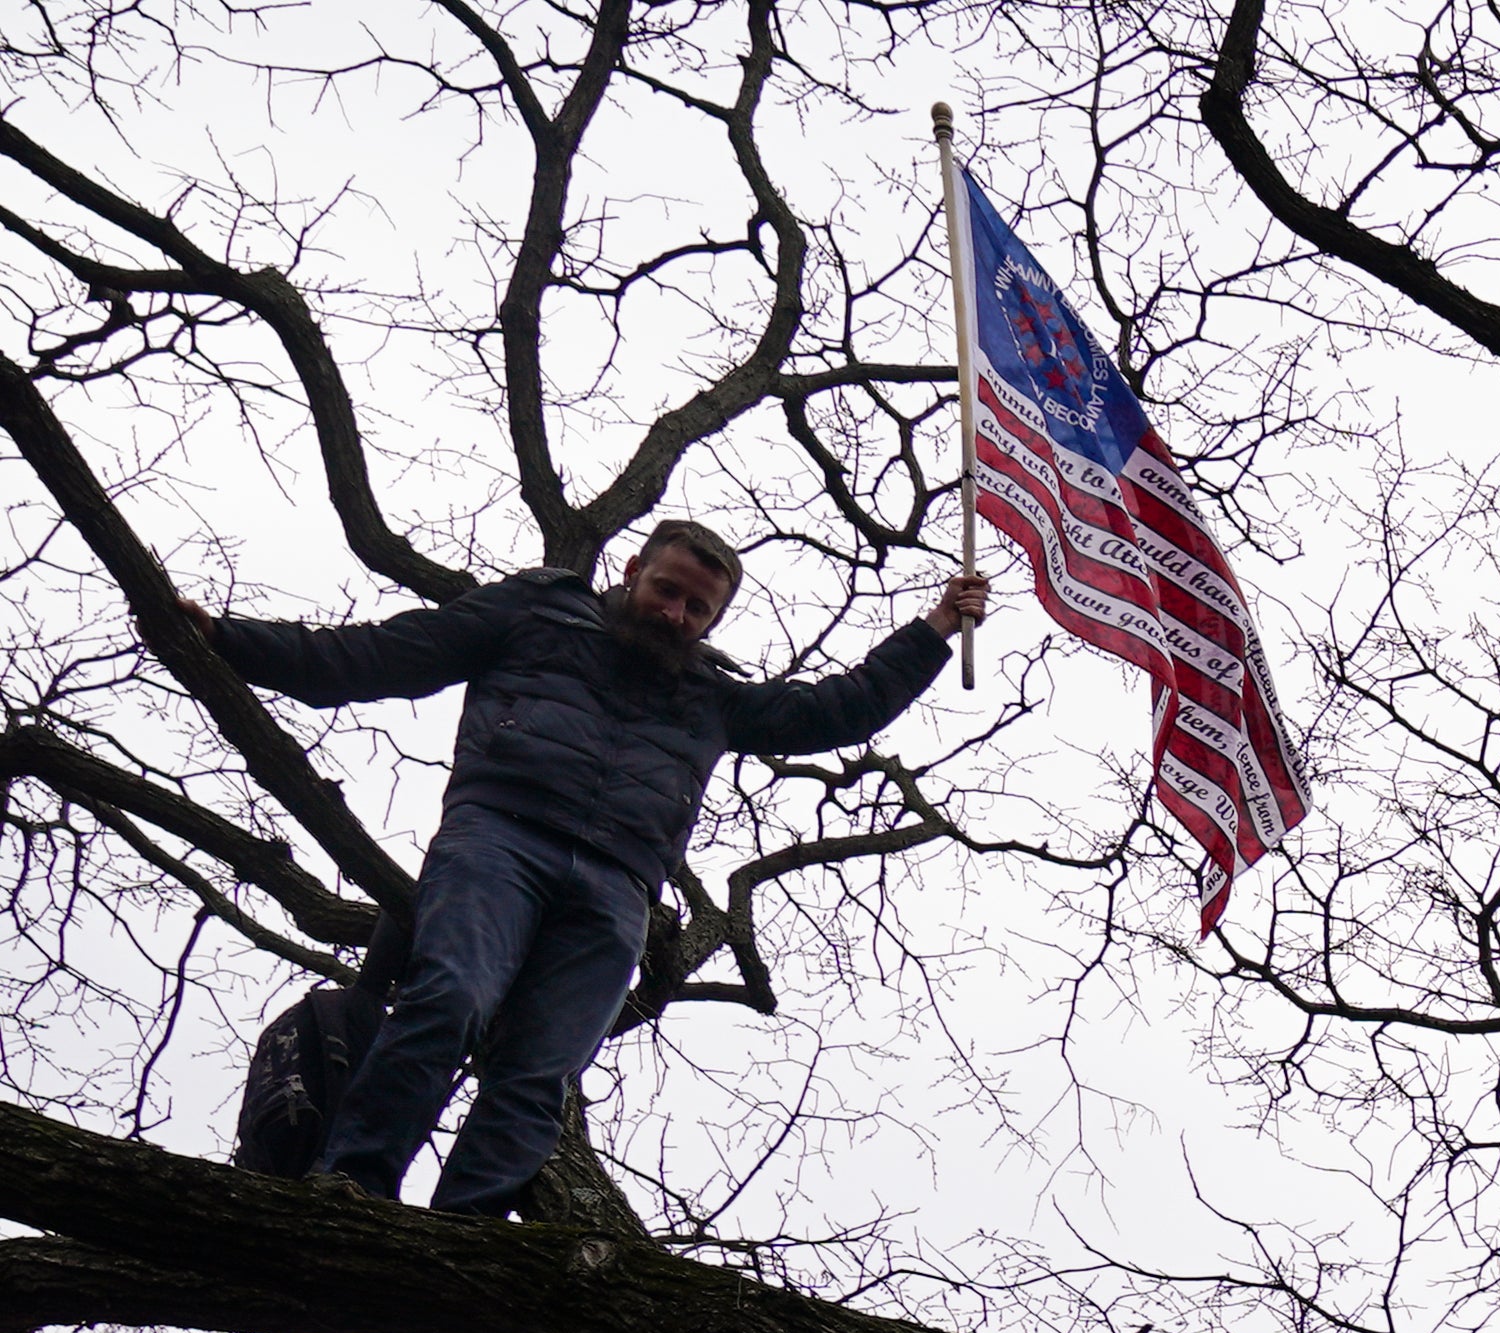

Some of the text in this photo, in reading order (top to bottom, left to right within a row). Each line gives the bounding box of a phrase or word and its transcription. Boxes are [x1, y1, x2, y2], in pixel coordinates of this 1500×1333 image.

[981, 418, 1016, 456] any
[1021, 453, 1057, 491] who
[1080, 469, 1106, 490] to
[975, 462, 1113, 616] include Their own
[1188, 570, 1242, 617] have
[1206, 657, 1240, 690] of
[1252, 787, 1275, 837] from
